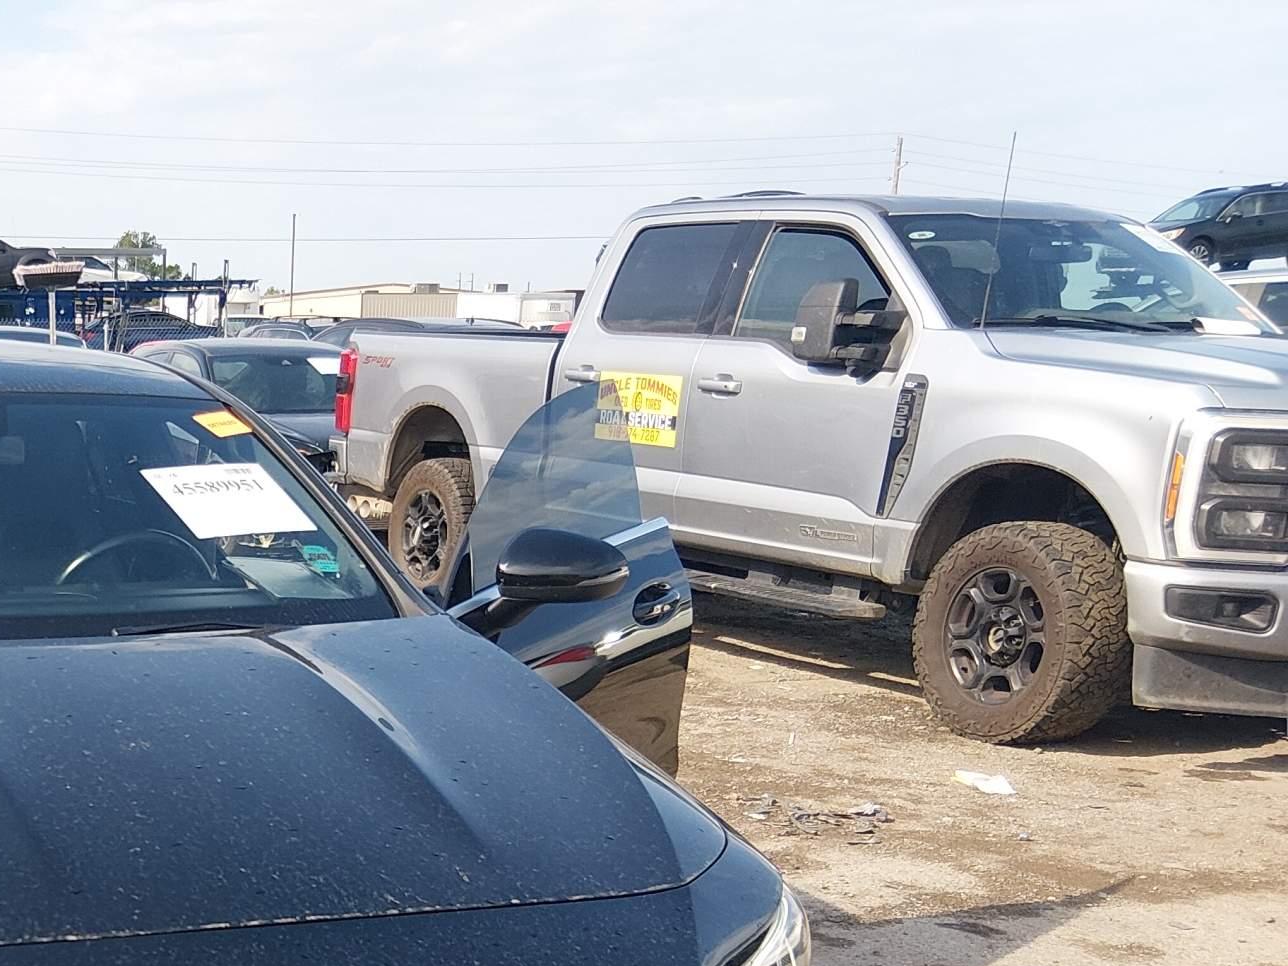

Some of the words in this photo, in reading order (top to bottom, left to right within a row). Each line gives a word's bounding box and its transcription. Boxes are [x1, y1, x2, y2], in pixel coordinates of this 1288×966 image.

[635, 376, 678, 406] TOMMIES
[627, 411, 673, 431] SERVICE
[173, 479, 265, 496] 45589951
